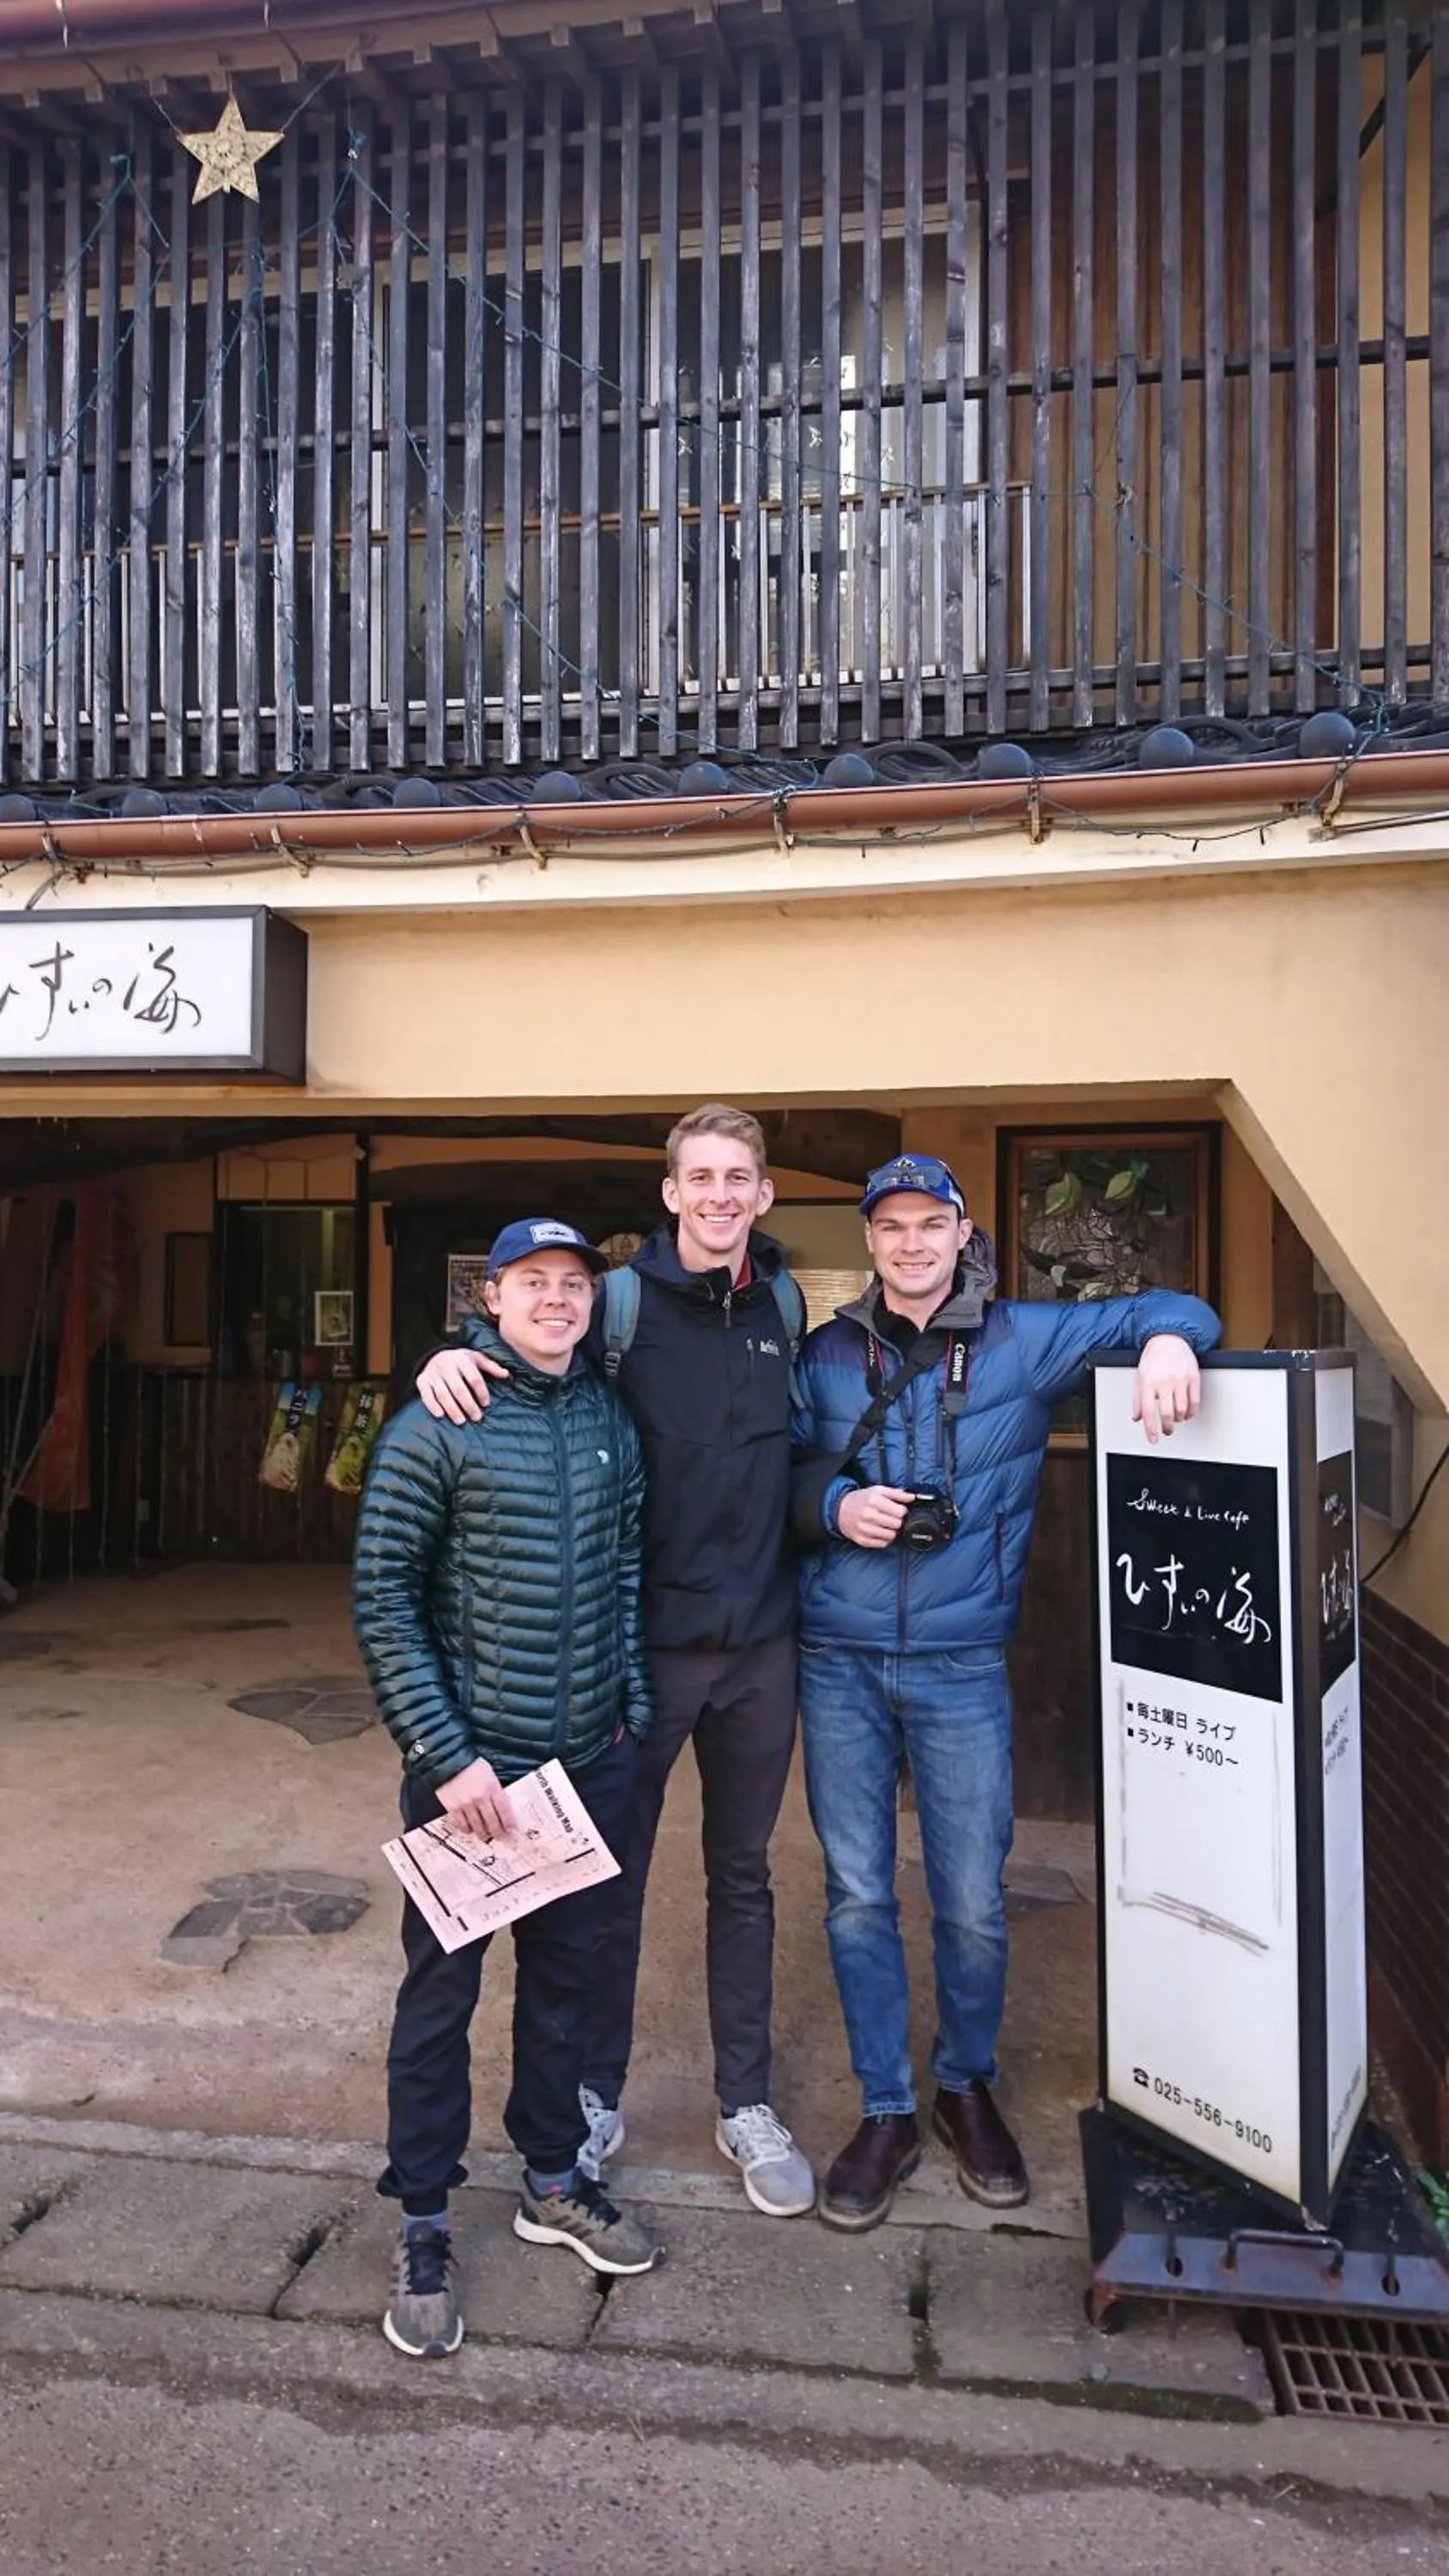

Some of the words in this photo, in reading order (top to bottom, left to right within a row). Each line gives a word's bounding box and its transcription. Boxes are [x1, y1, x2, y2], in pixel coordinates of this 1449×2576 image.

[951, 1344, 966, 1382] Canon
[1197, 1505, 1221, 1521] Live
[1137, 1701, 1188, 1730] 毎土曜日
[1196, 1718, 1237, 1741] ライブ
[1137, 1728, 1175, 1751] ランチ
[1154, 2076, 1272, 2153] 025-556-9100
